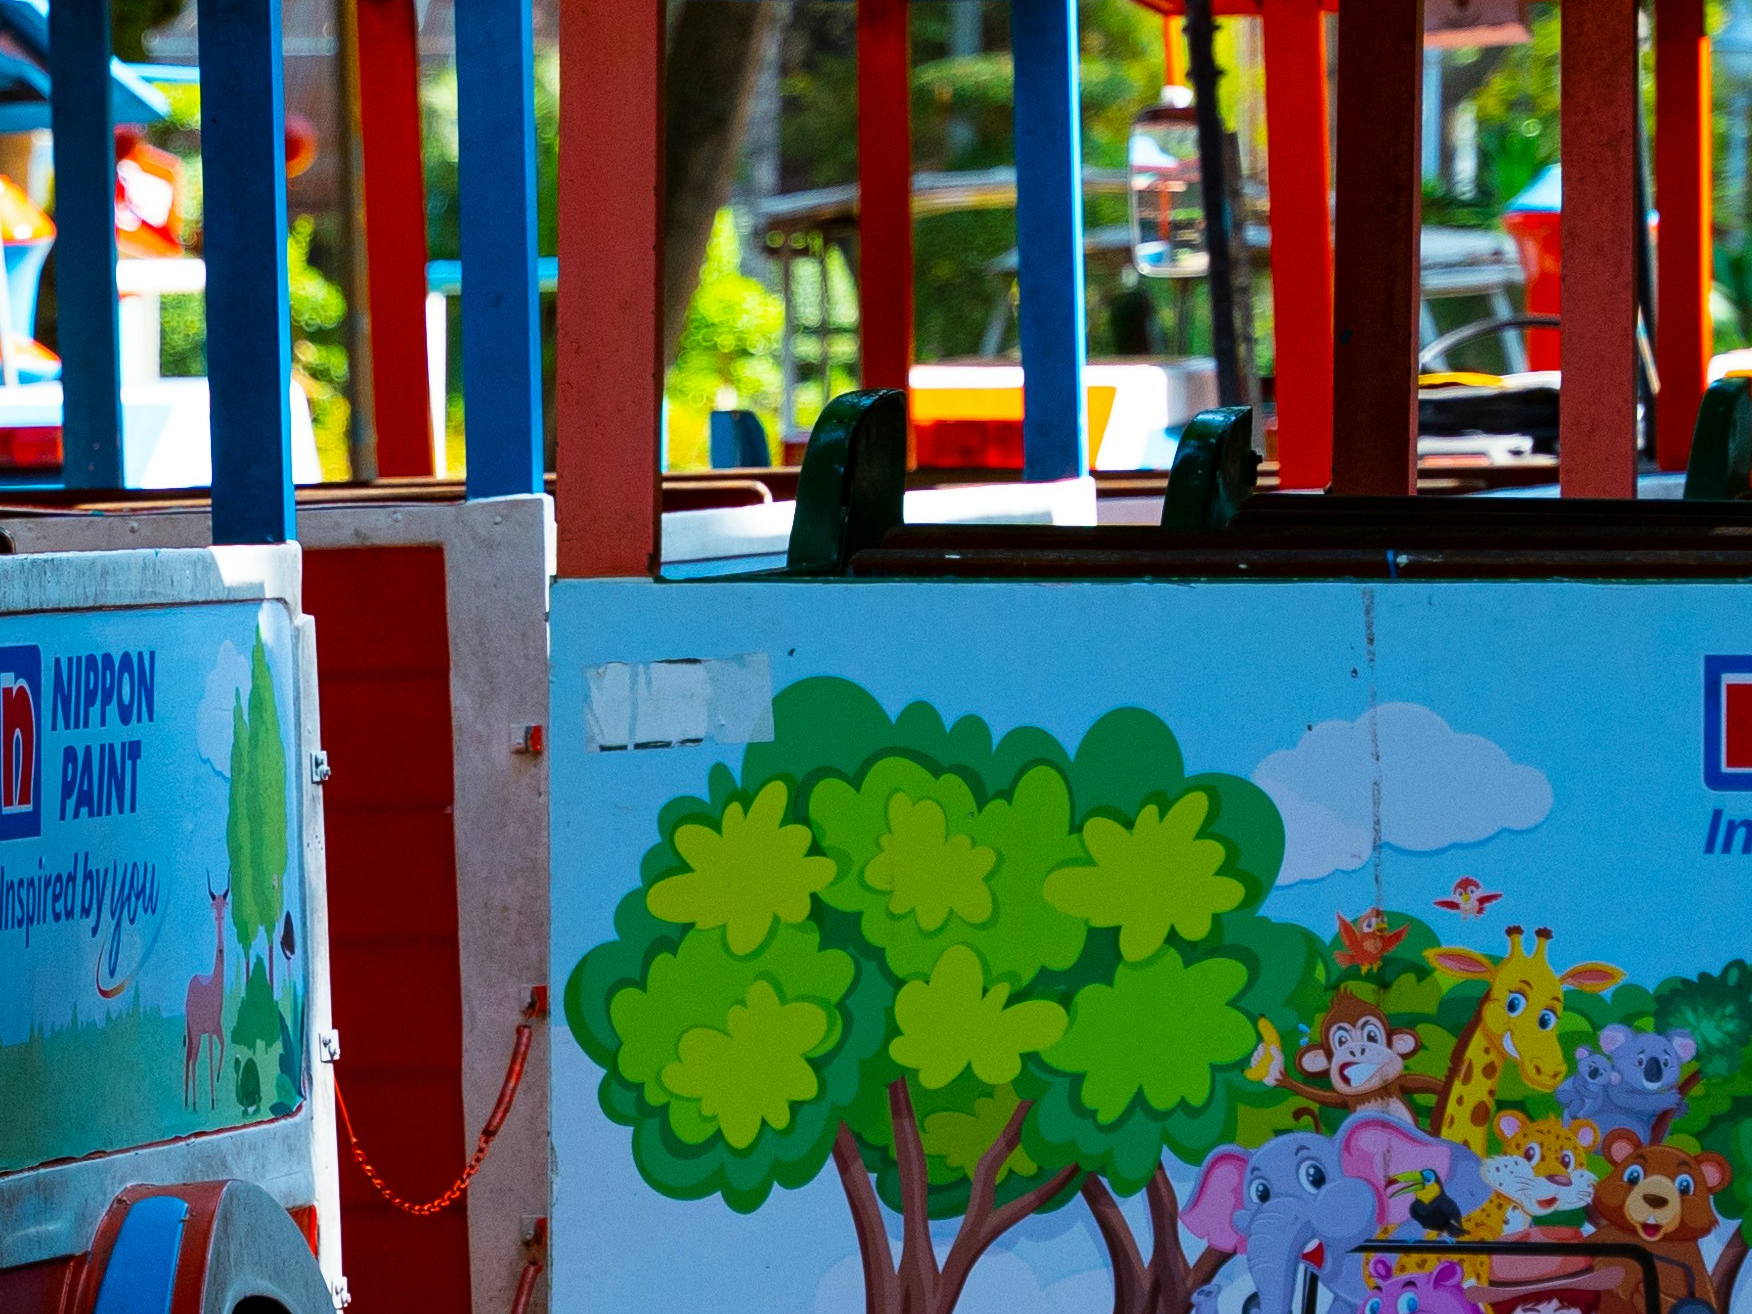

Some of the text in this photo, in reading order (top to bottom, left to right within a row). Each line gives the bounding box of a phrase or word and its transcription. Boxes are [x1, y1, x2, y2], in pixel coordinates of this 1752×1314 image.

[51, 650, 156, 732] NIPPON
[59, 739, 142, 821] PAINT
[80, 851, 109, 938] by
[108, 858, 160, 979] you
